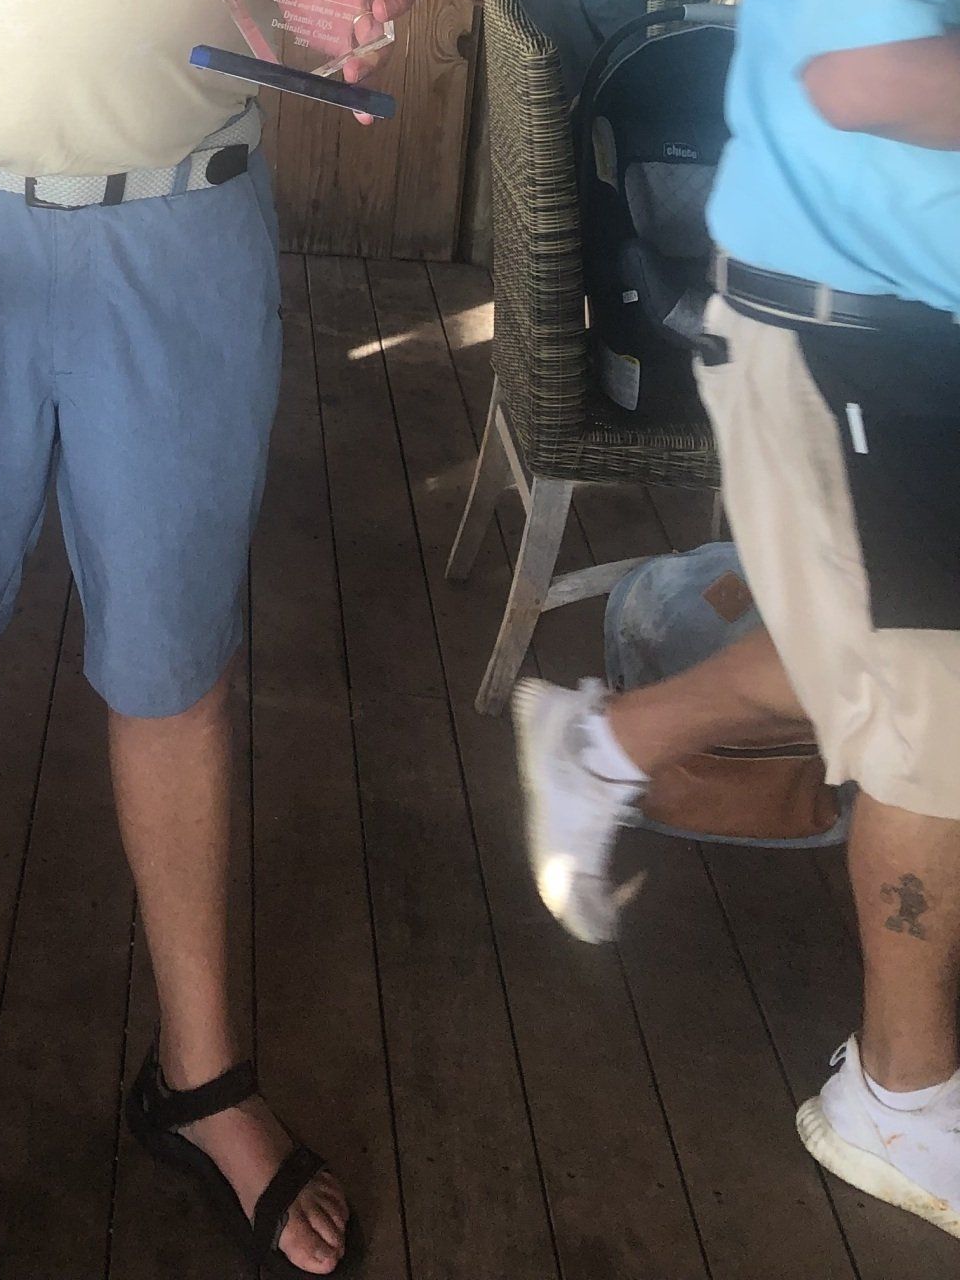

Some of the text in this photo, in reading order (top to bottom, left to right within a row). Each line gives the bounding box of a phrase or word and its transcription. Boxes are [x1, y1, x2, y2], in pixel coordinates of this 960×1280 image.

[283, 10, 314, 25] Dynamic
[271, 18, 311, 36] Destination
[294, 36, 310, 48] 2021
